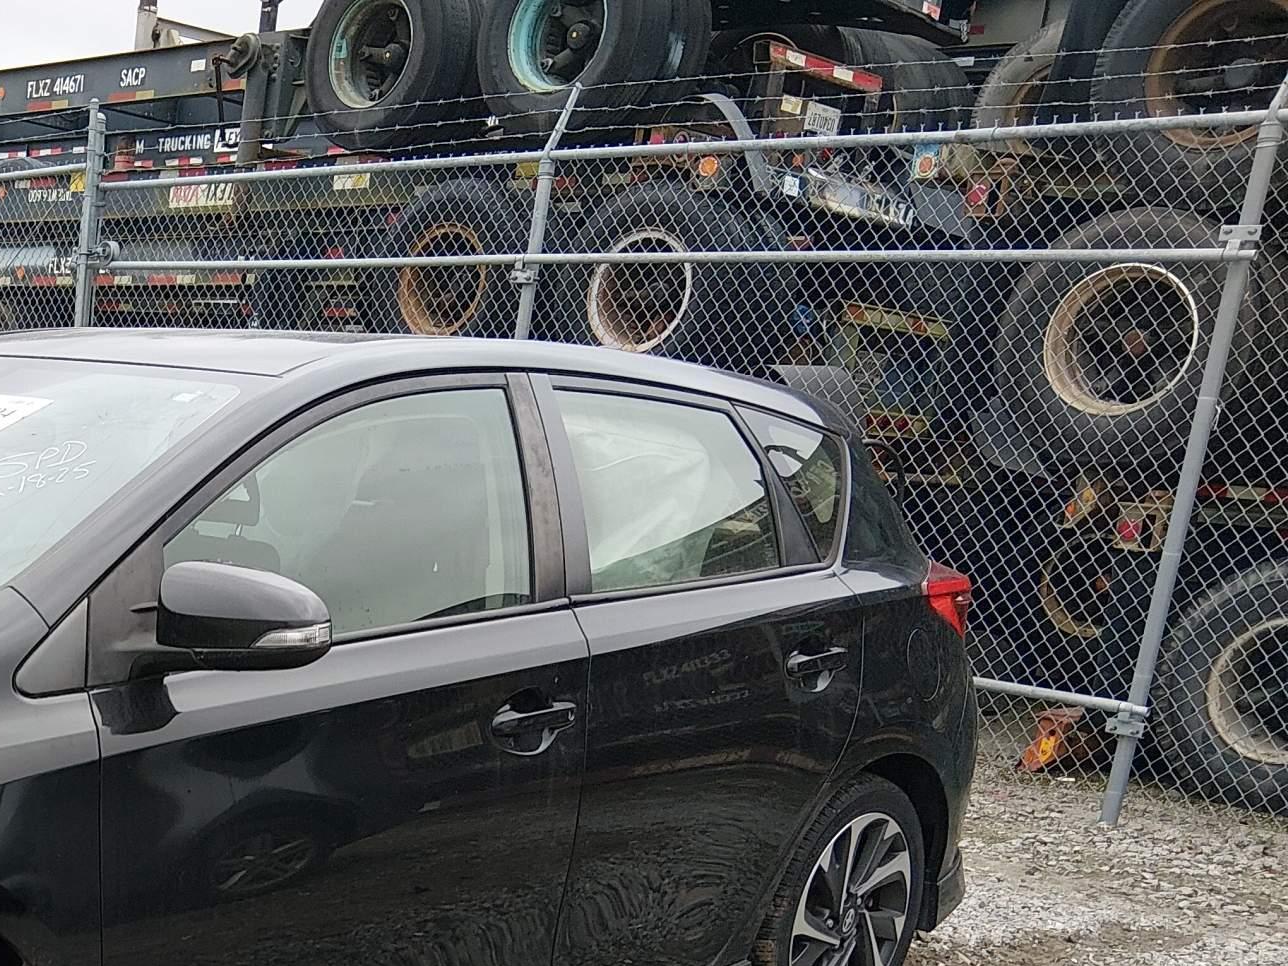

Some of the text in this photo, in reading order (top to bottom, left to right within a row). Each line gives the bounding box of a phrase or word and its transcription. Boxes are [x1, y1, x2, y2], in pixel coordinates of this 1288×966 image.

[27, 74, 85, 99] FLXZ 414671
[120, 67, 146, 88] SACP
[158, 132, 211, 154] TRUCKING
[48, 256, 73, 274] FLXZ
